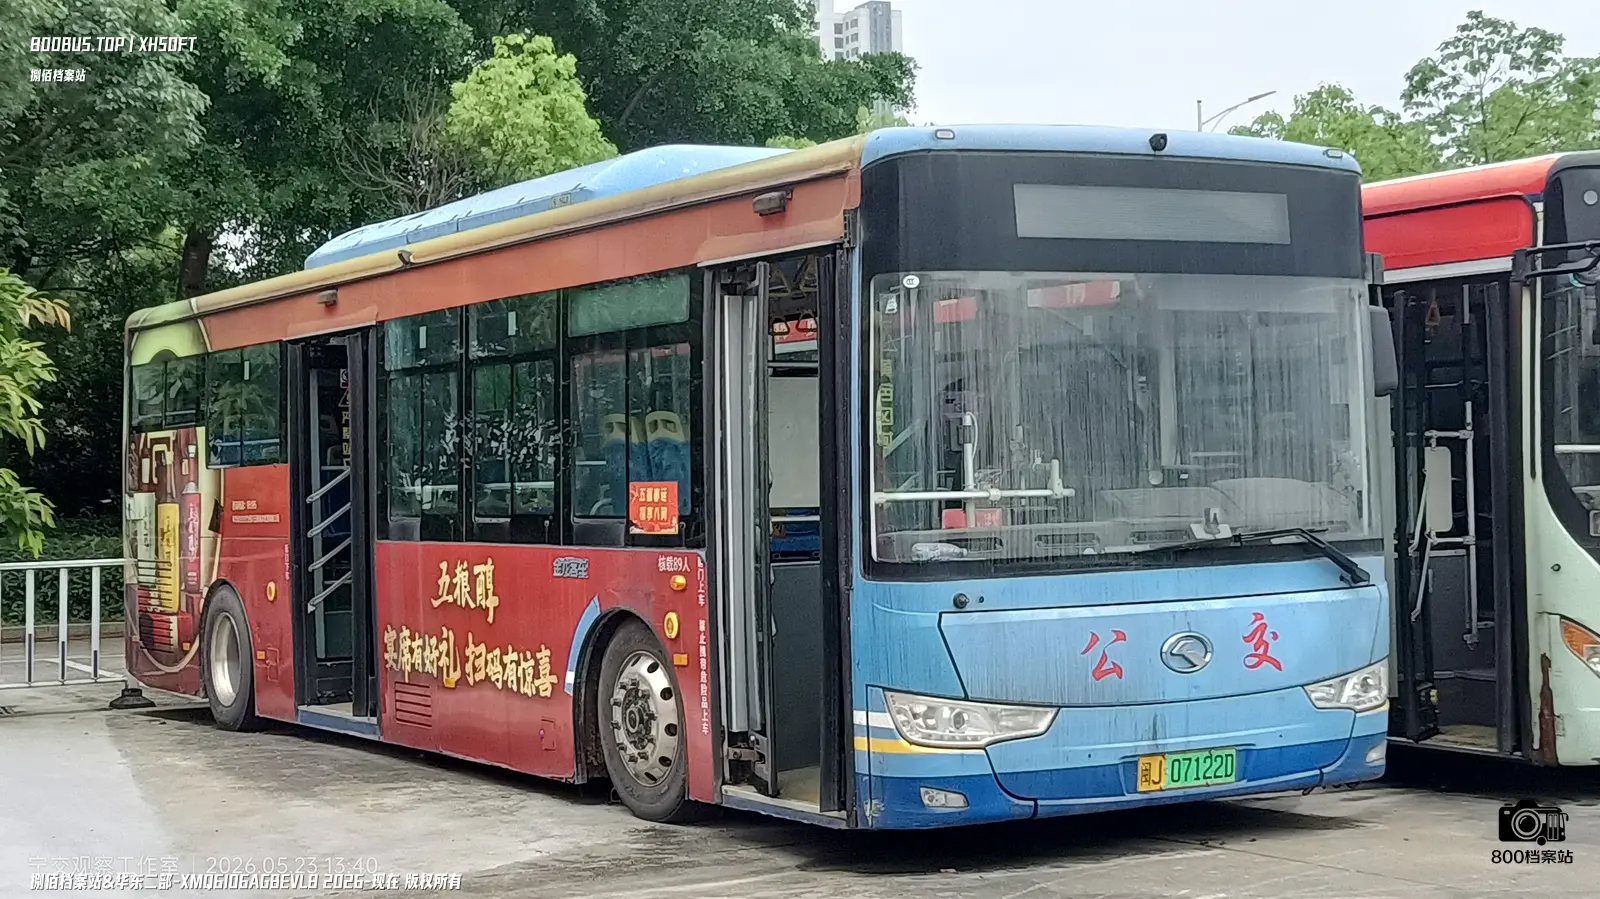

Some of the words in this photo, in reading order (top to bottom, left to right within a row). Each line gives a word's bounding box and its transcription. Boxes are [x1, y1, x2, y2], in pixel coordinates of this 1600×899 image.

[464, 632, 558, 698] 扫码有惊喜
[1081, 630, 1127, 681] 公
[1242, 612, 1283, 672] 交
